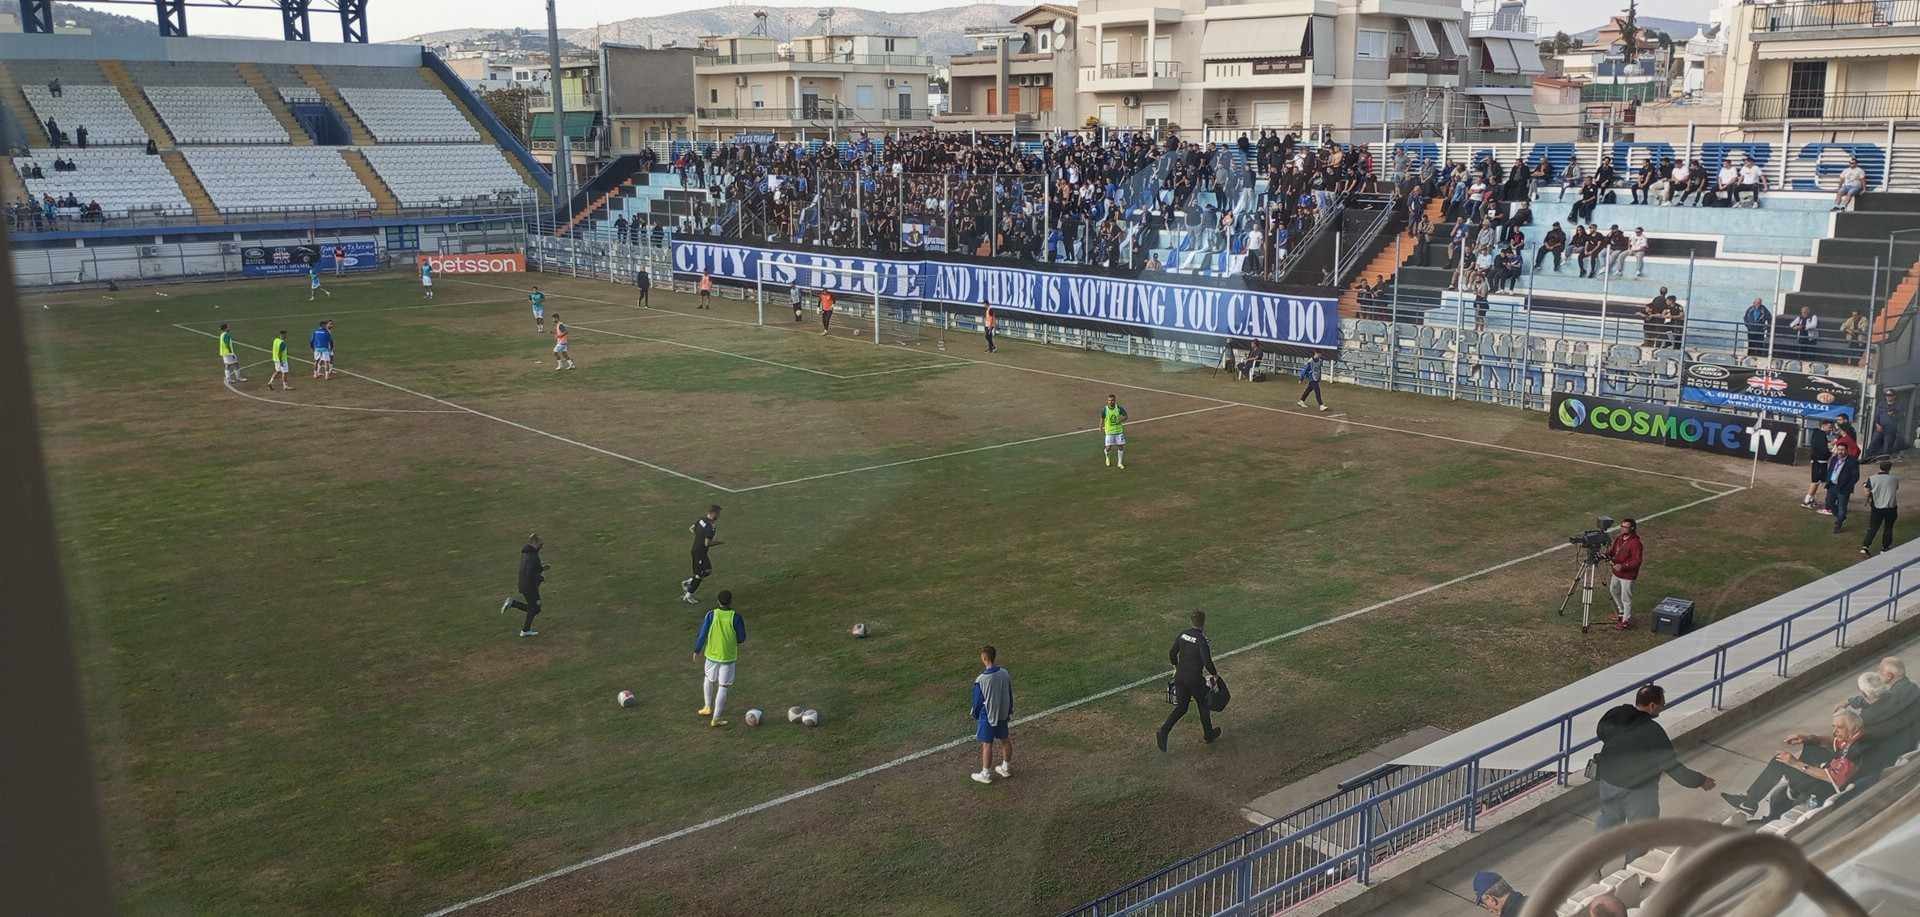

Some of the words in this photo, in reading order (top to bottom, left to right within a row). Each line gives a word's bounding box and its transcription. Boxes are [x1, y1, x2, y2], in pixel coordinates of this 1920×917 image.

[428, 256, 517, 273] betsson
[675, 243, 750, 278] CITY
[760, 252, 799, 284] IS
[810, 257, 920, 297] BLUE
[933, 264, 971, 301] AND
[975, 268, 1036, 310] THERE
[1041, 276, 1062, 313] IS
[1067, 277, 1167, 326] NOTHING
[1173, 287, 1222, 333] YOU
[1227, 293, 1281, 339] CAN
[1287, 299, 1325, 344] DO
[1755, 370, 1782, 379] CITY
[1746, 386, 1786, 397] ROVER
[1727, 400, 1804, 415] www.cityrover.gr
[1757, 395, 1773, 405] 322
[1745, 426, 1788, 456] TV
